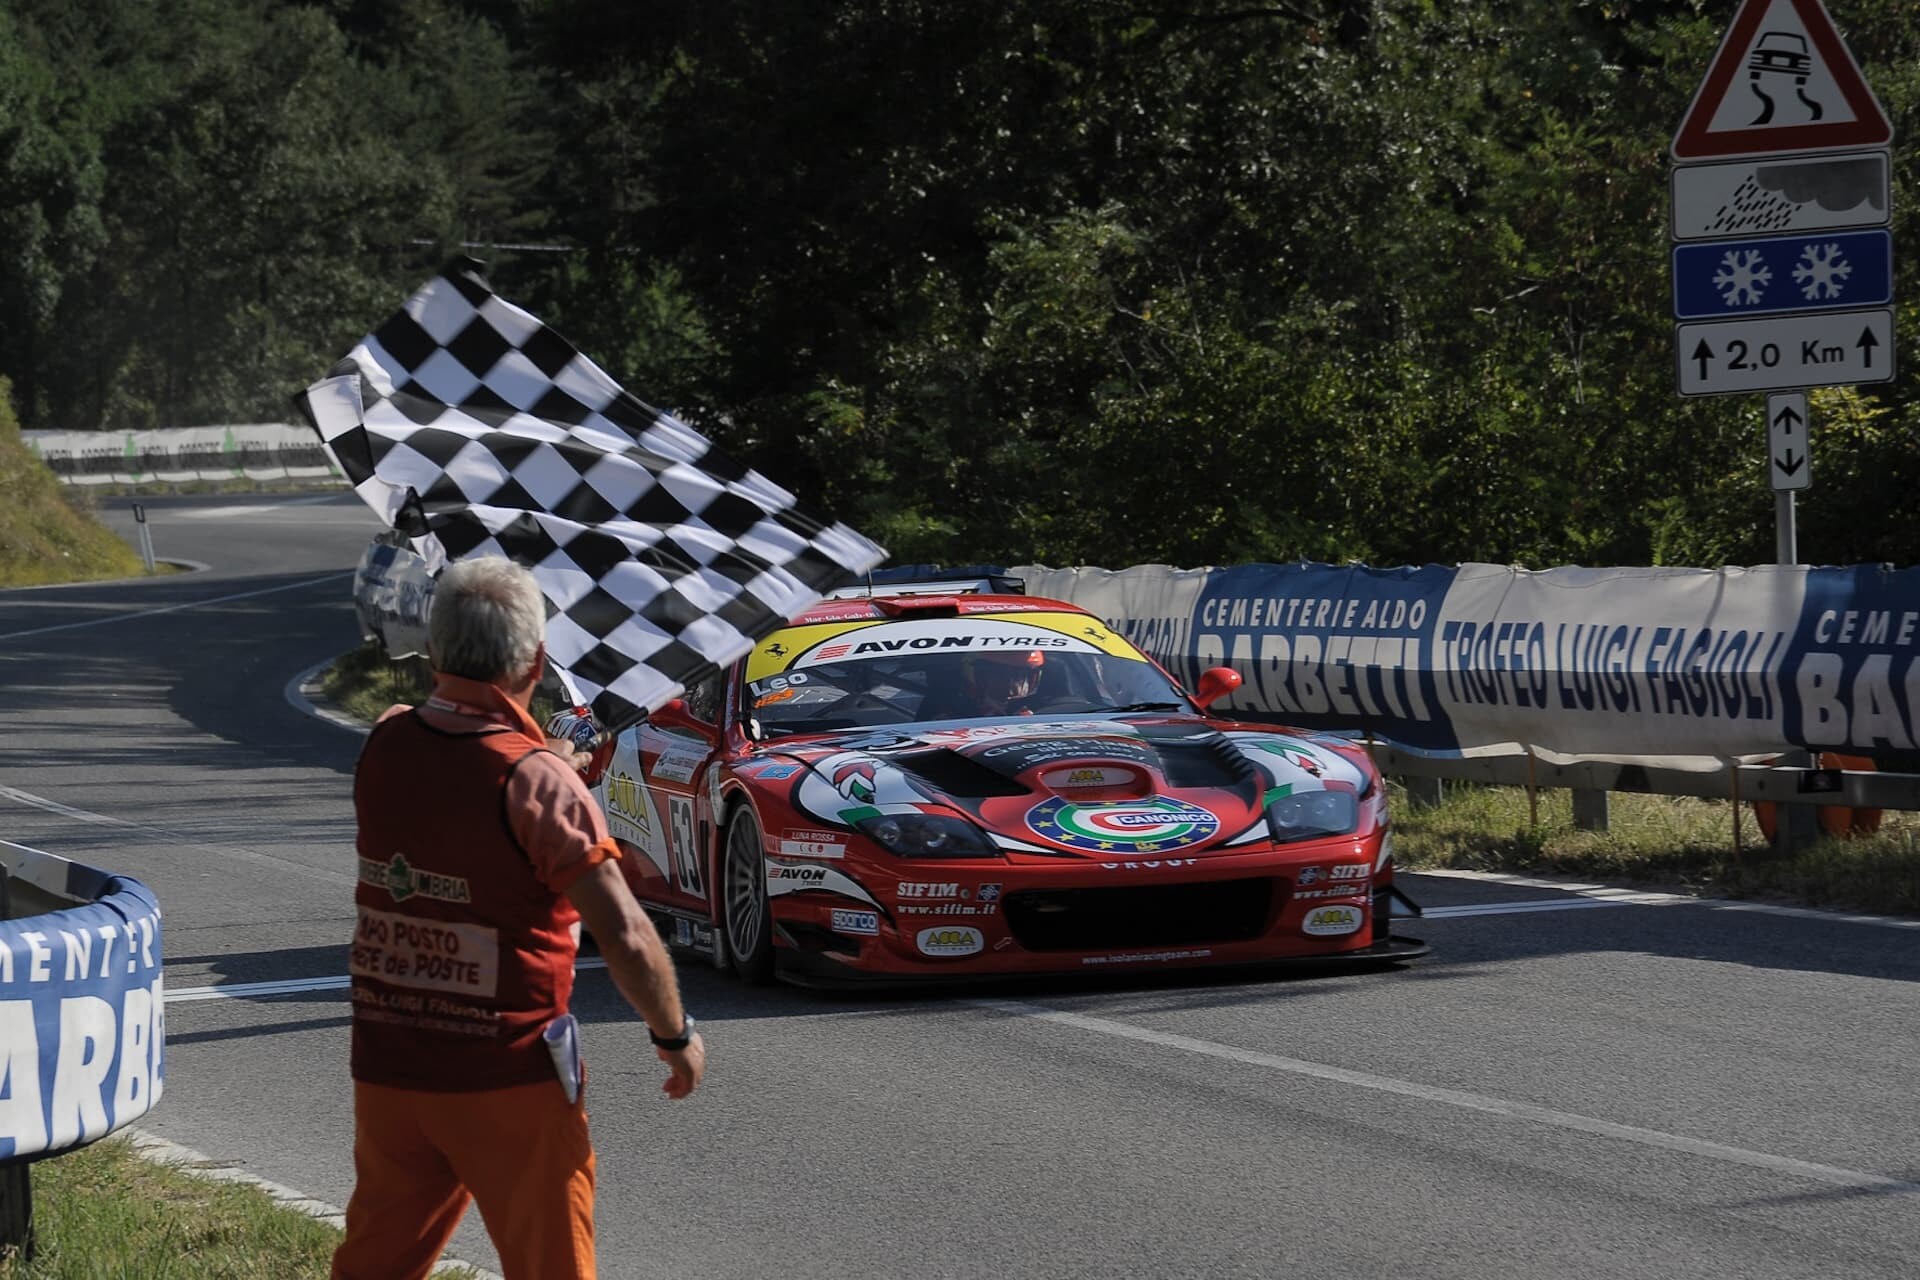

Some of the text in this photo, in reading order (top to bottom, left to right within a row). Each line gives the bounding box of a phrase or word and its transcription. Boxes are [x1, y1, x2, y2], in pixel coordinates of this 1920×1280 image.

[1726, 339, 1845, 372] 2,0 Km
[1202, 598, 1427, 629] CEMENTERIE ALDO
[853, 636, 1069, 654] AVON TYRES
[1442, 621, 1785, 720] TROFEO LUIGI FAGIOLI
[750, 673, 808, 697] Leo
[1119, 813, 1213, 824] CANONICO
[671, 801, 701, 893] 53
[780, 868, 827, 880] AVON
[897, 883, 960, 898] SIFIM
[833, 910, 876, 929] sparco
[897, 904, 997, 915] www.sifim.it
[394, 921, 460, 955] POSTO
[414, 953, 481, 986] POSTE
